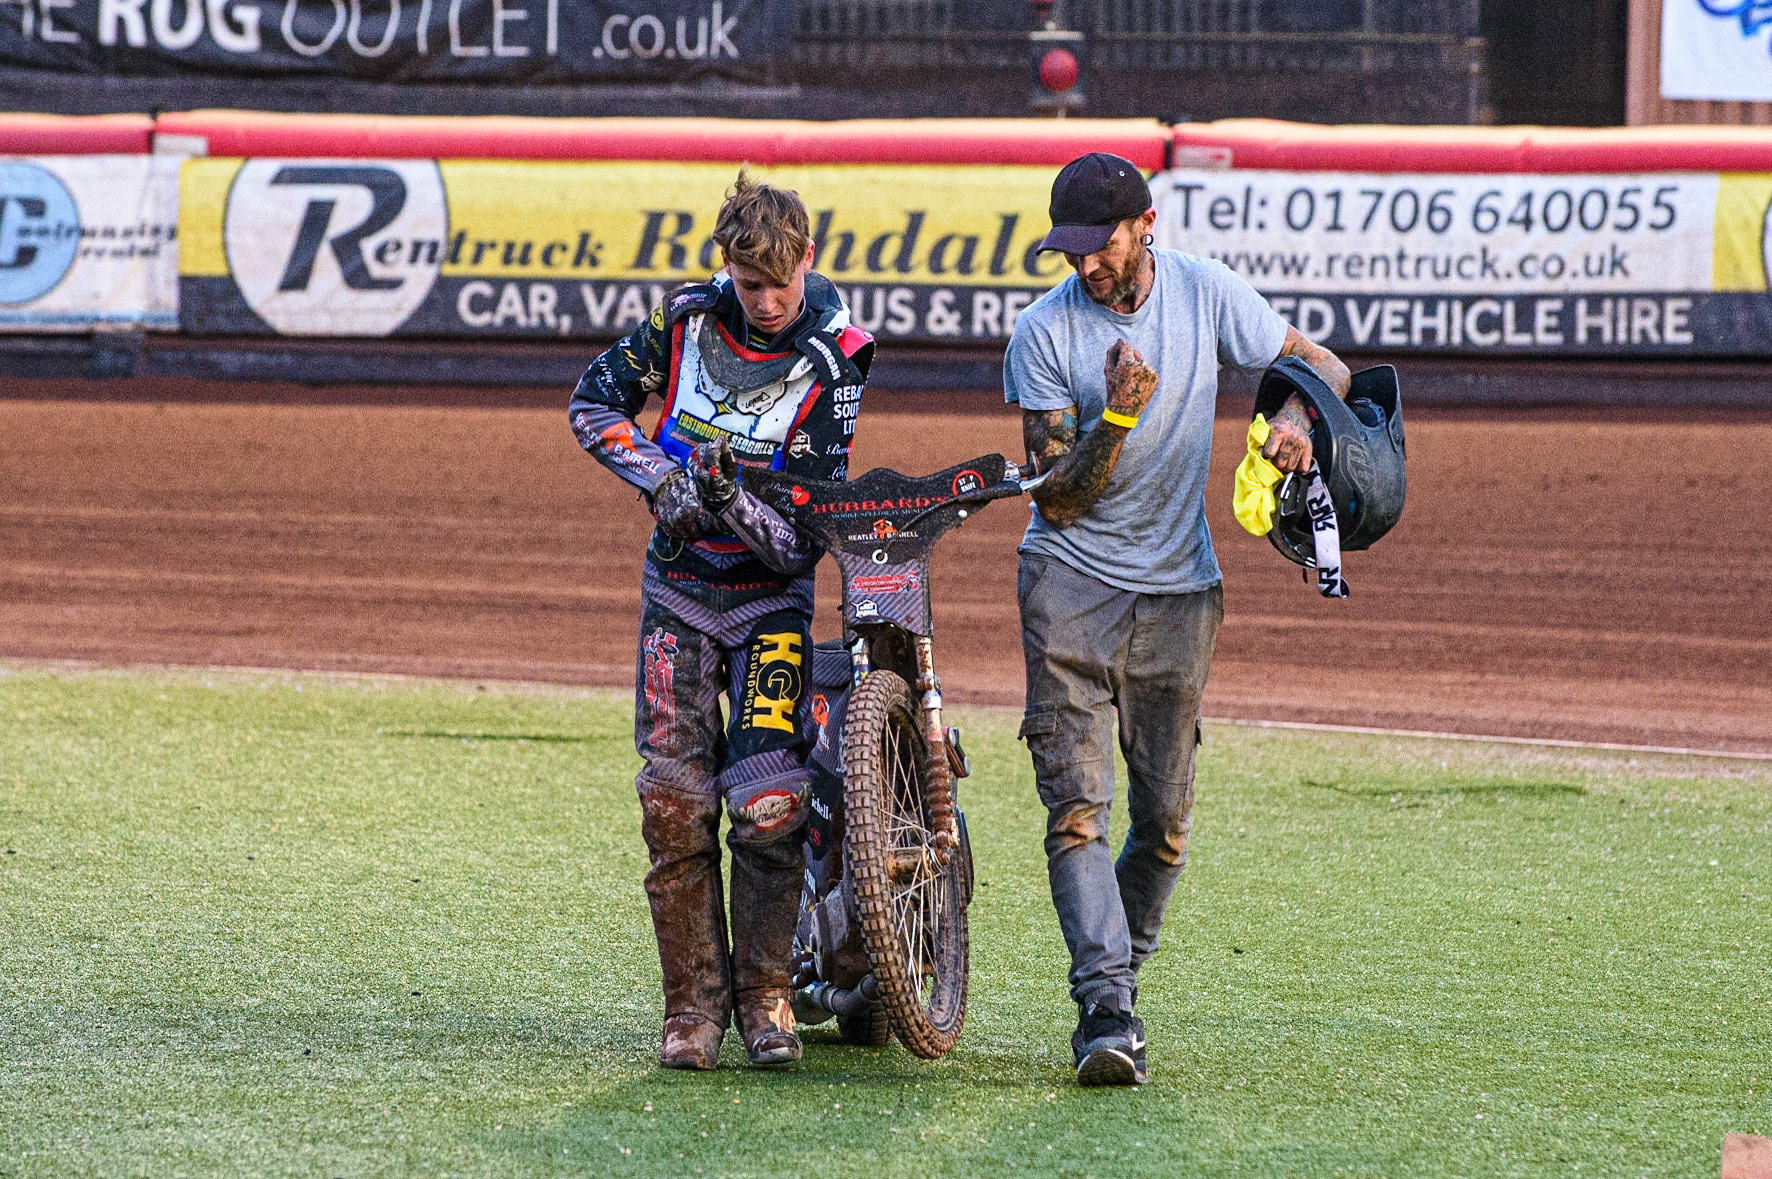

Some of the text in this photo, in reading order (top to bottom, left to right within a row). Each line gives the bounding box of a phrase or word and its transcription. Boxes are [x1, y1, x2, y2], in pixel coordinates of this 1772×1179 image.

[1173, 183, 1679, 234] Tel: 01706 640055
[632, 209, 1064, 277] Rohdale
[457, 281, 572, 335] CAR,
[925, 288, 963, 336] &
[1343, 299, 1564, 346] VEHICLE
[1574, 299, 1694, 345] HIRE
[807, 336, 841, 381] MORGAN
